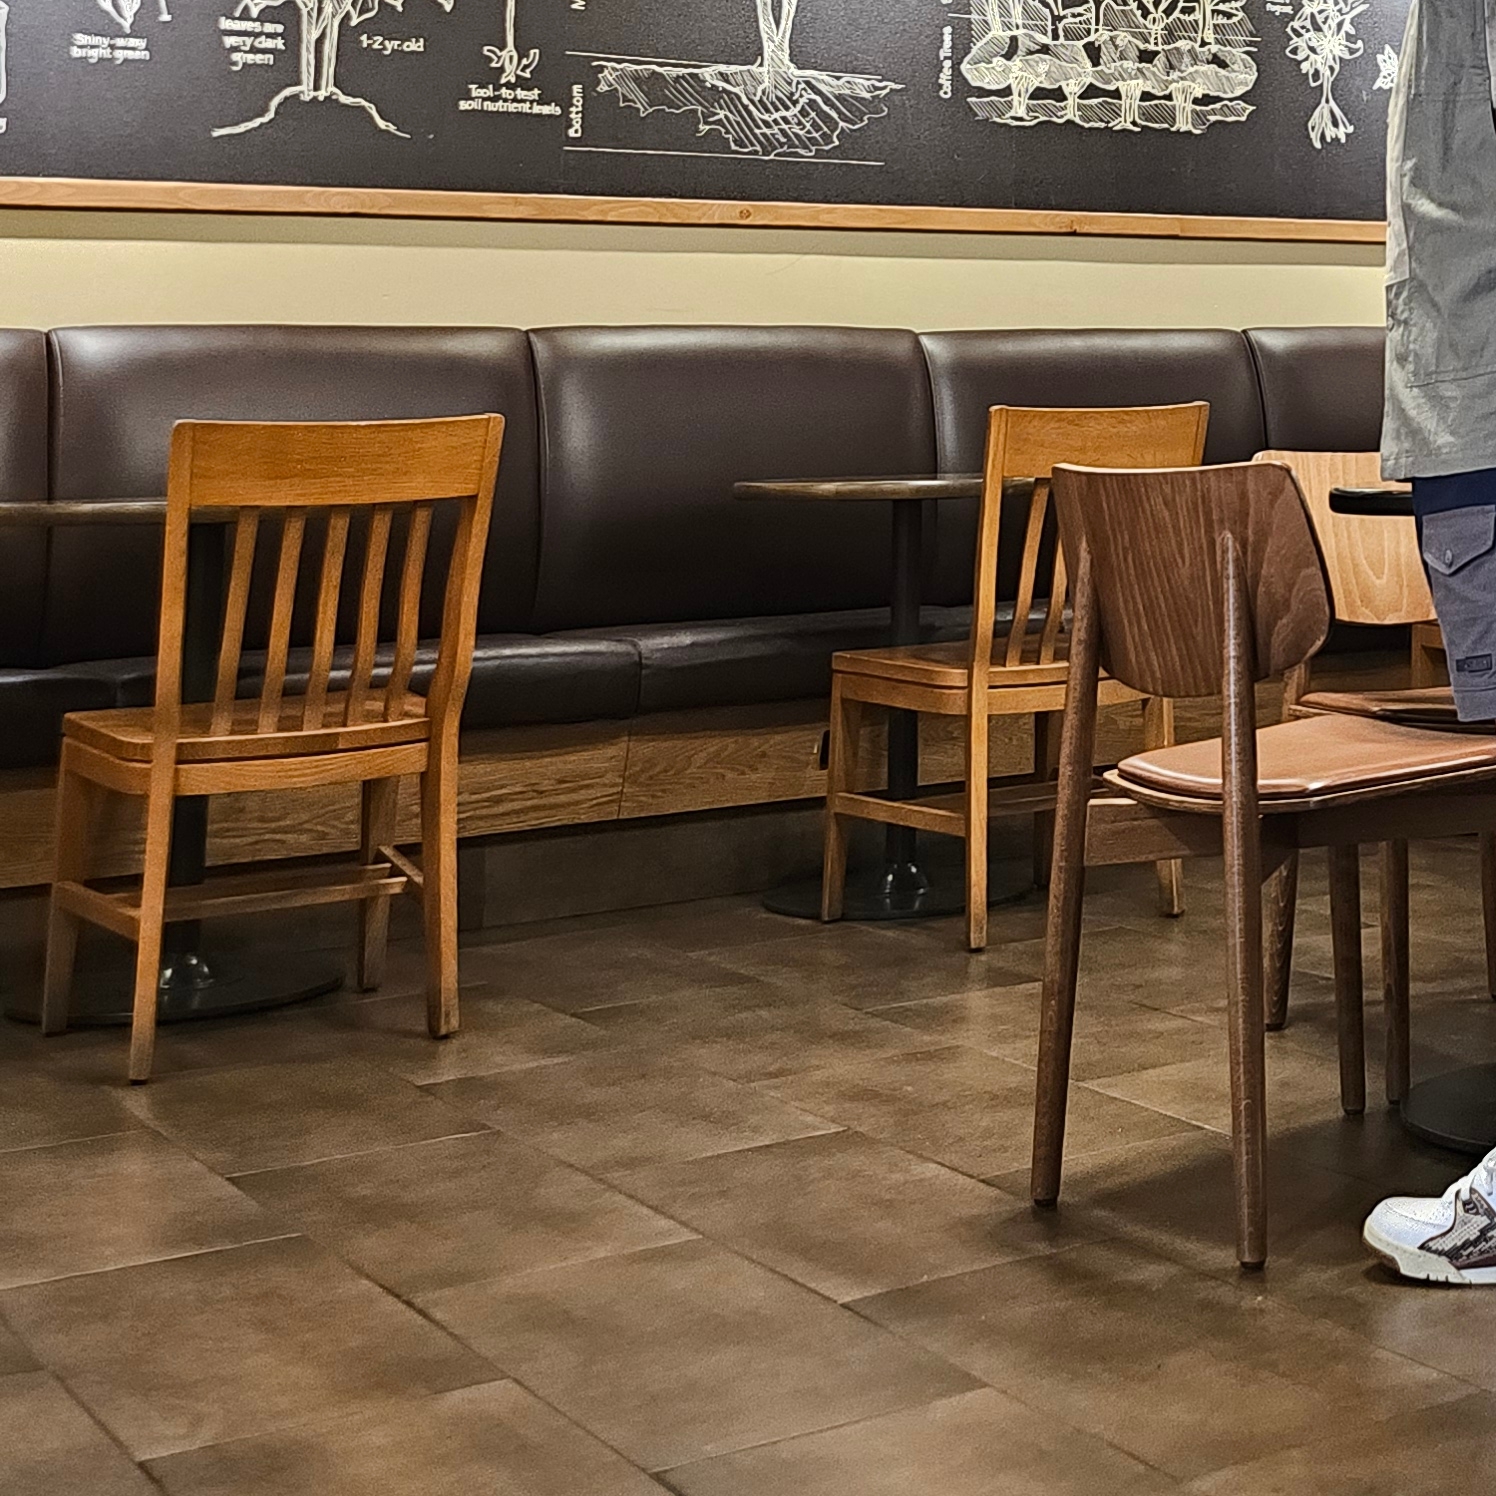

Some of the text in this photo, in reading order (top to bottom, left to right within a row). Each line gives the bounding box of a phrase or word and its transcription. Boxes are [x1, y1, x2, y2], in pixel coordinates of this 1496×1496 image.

[222, 35, 286, 51] very dark
[939, 25, 953, 60] Trees
[70, 45, 113, 64] bright
[230, 52, 274, 71] green
[515, 87, 541, 100] test
[459, 98, 482, 110] soil
[483, 100, 532, 113] nutrient
[567, 84, 583, 138] Bottom
